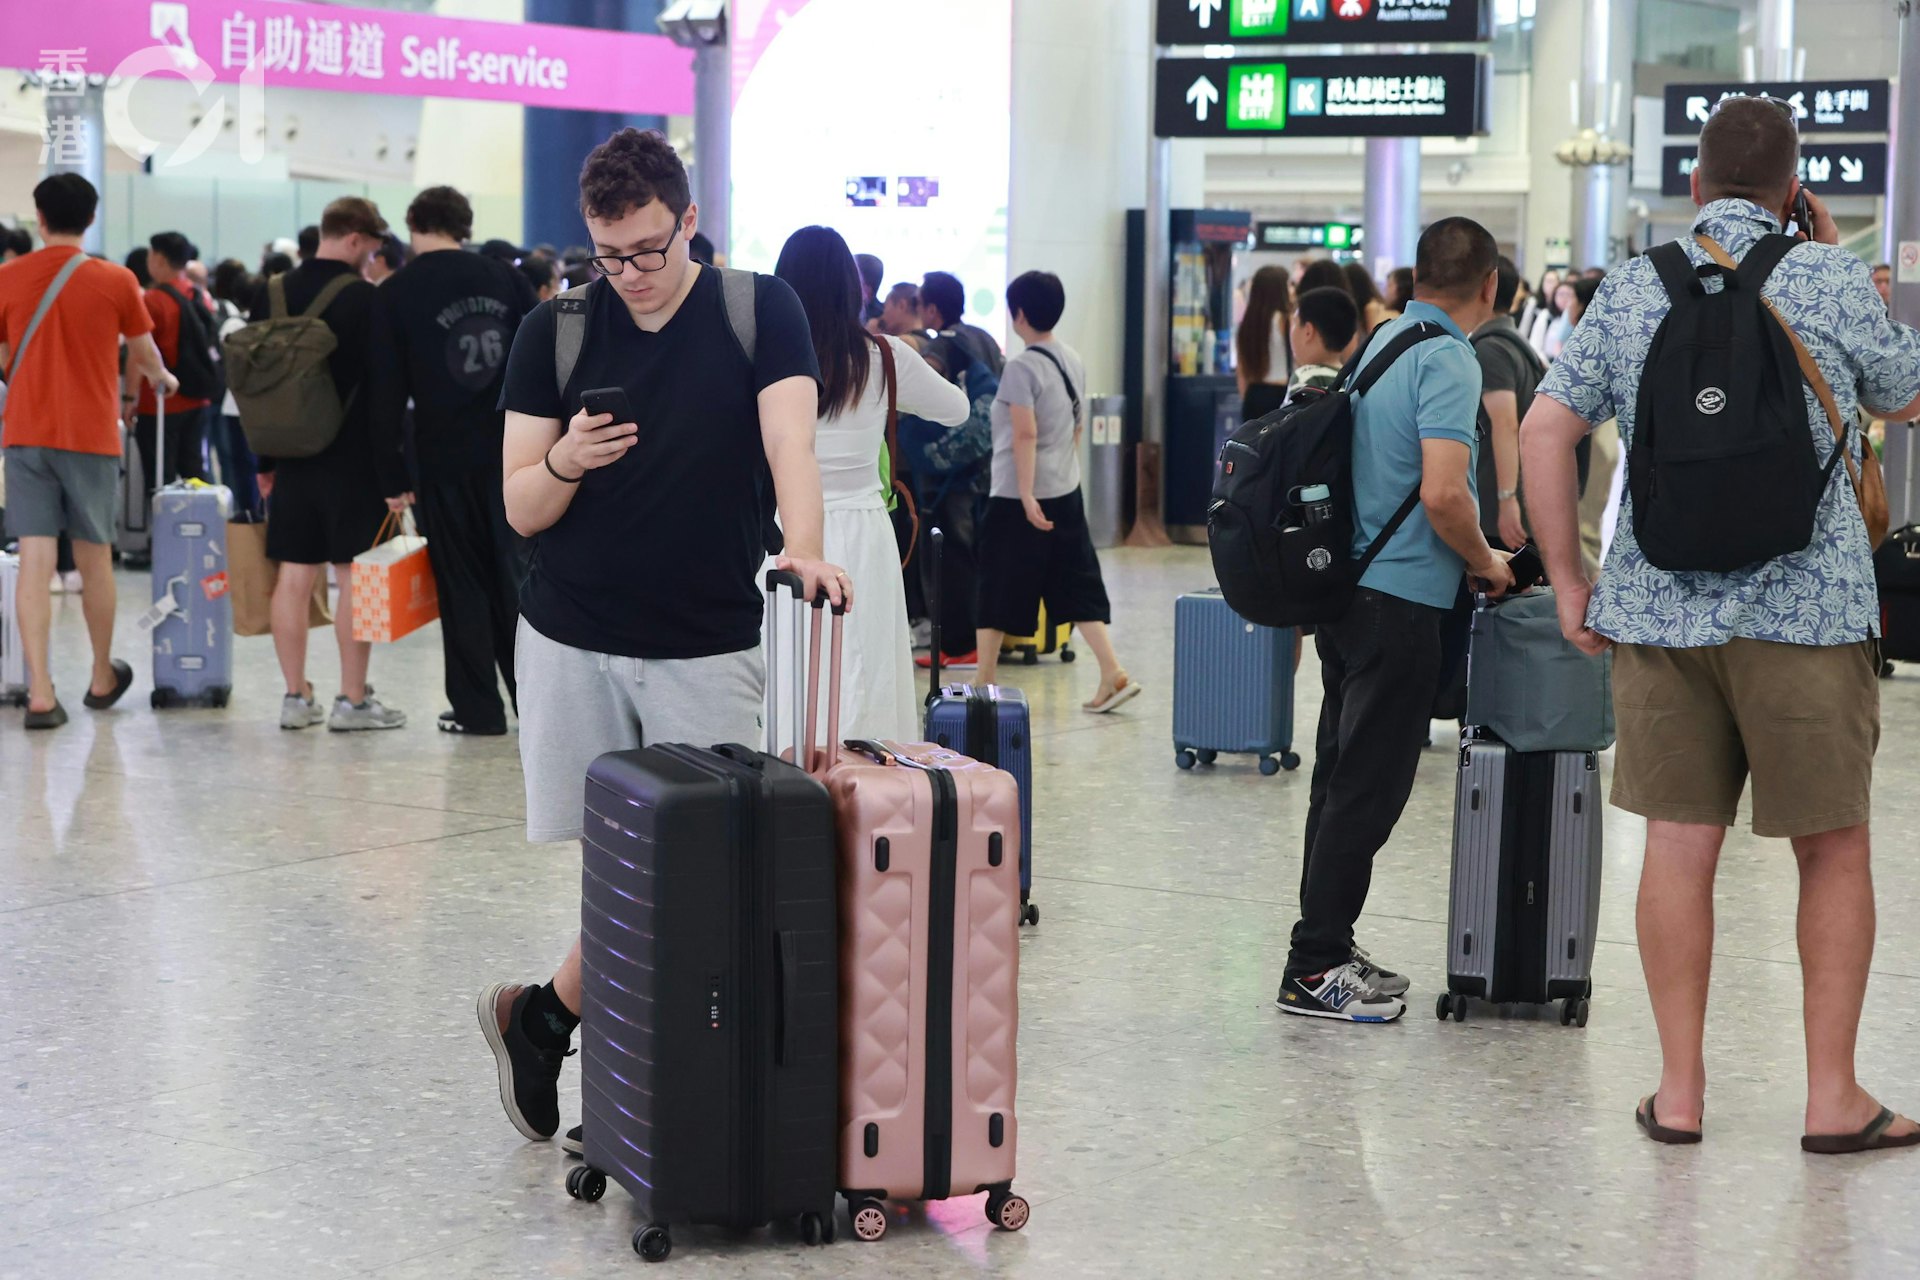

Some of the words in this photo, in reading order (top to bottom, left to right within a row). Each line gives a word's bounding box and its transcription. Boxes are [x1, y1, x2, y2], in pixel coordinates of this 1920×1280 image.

[1241, 14, 1274, 28] EXIT
[1377, 8, 1409, 21] Austin
[1411, 8, 1447, 20] Station
[221, 10, 386, 80] 自助通道
[400, 35, 568, 90] Self-service
[1297, 83, 1316, 111] K
[1815, 89, 1869, 112] 洗手間
[1239, 106, 1272, 121] EXIT
[435, 295, 509, 330] PROTOTYPE
[458, 328, 504, 374] 26
